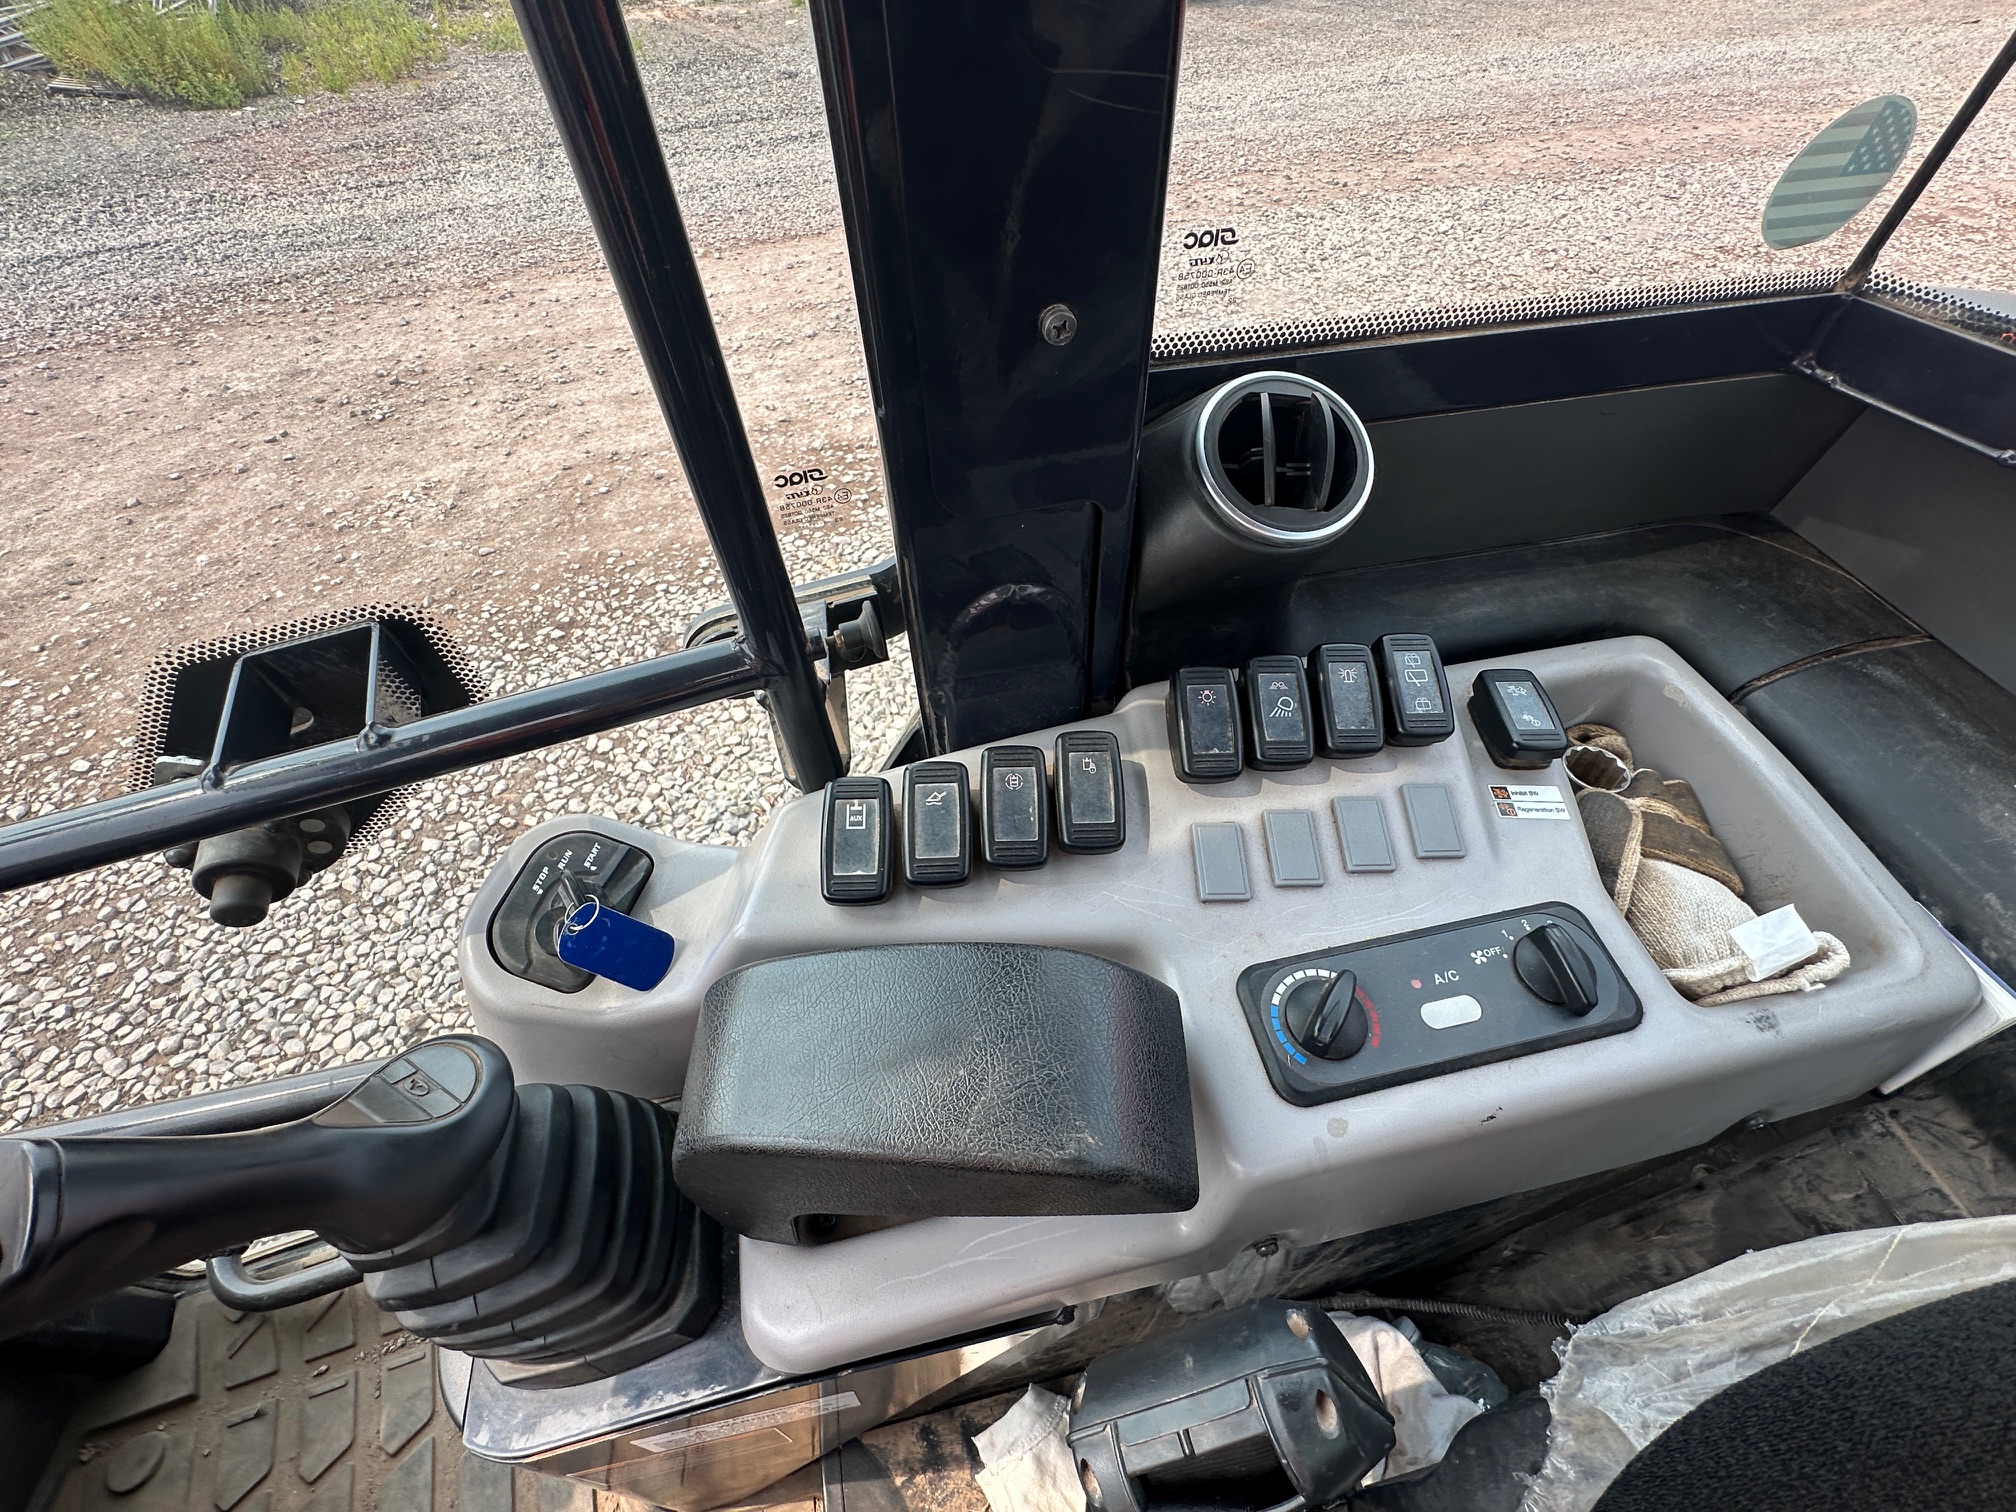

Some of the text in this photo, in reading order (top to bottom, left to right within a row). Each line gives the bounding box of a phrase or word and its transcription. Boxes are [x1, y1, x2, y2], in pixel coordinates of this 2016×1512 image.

[849, 814, 863, 822] AUX
[557, 849, 574, 870] RUN
[583, 842, 602, 868] START
[532, 866, 550, 892] STOP
[1520, 919, 1528, 928] 2
[1483, 946, 1502, 957] OFF
[1434, 969, 1460, 986] A/C
